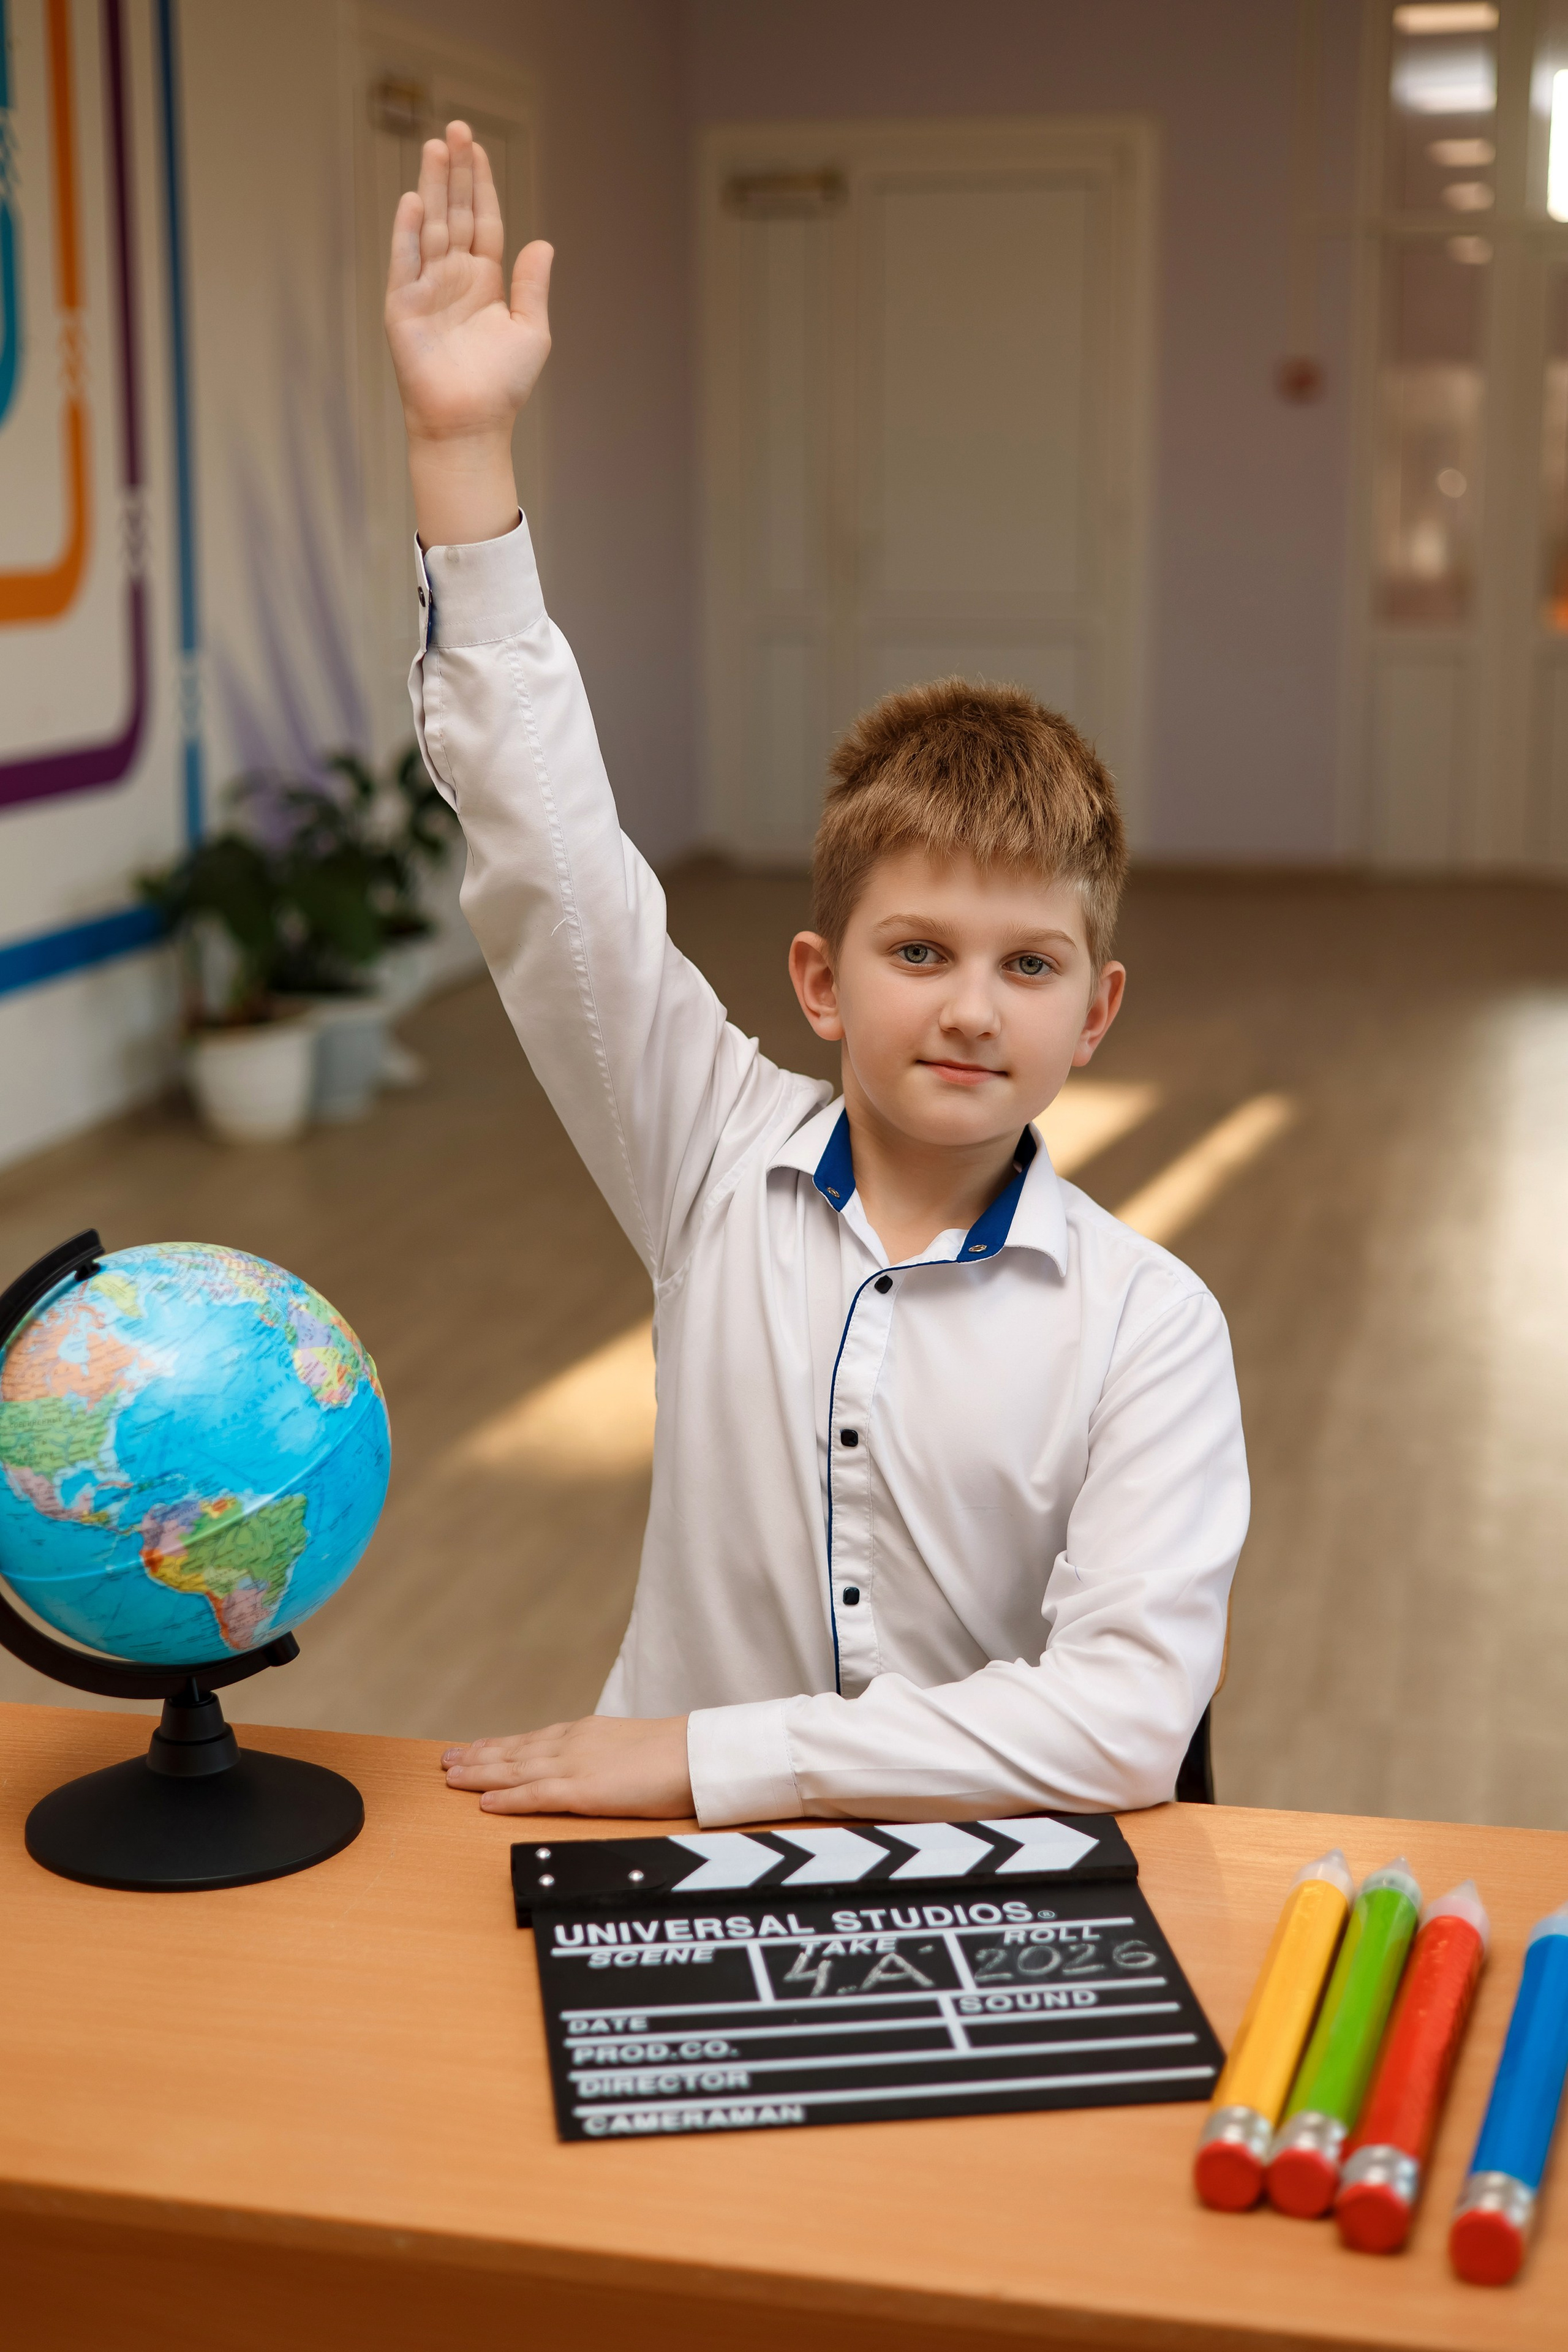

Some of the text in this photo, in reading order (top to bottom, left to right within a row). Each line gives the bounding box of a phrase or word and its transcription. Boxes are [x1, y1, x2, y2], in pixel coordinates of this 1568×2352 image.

[554, 1913, 815, 1947] UNIVERSAL
[1003, 1926, 1101, 1946] ROLL
[587, 1947, 715, 1969] SCENE
[800, 1937, 897, 1958] TAKE
[973, 1939, 1157, 1982] 2026
[959, 1989, 1098, 2013] SOUND
[568, 2016, 648, 2035] DATE
[573, 2040, 739, 2065] PROD.CO.
[578, 2070, 751, 2098] DIRECTOR
[582, 2105, 805, 2136] CAMERAMAN
